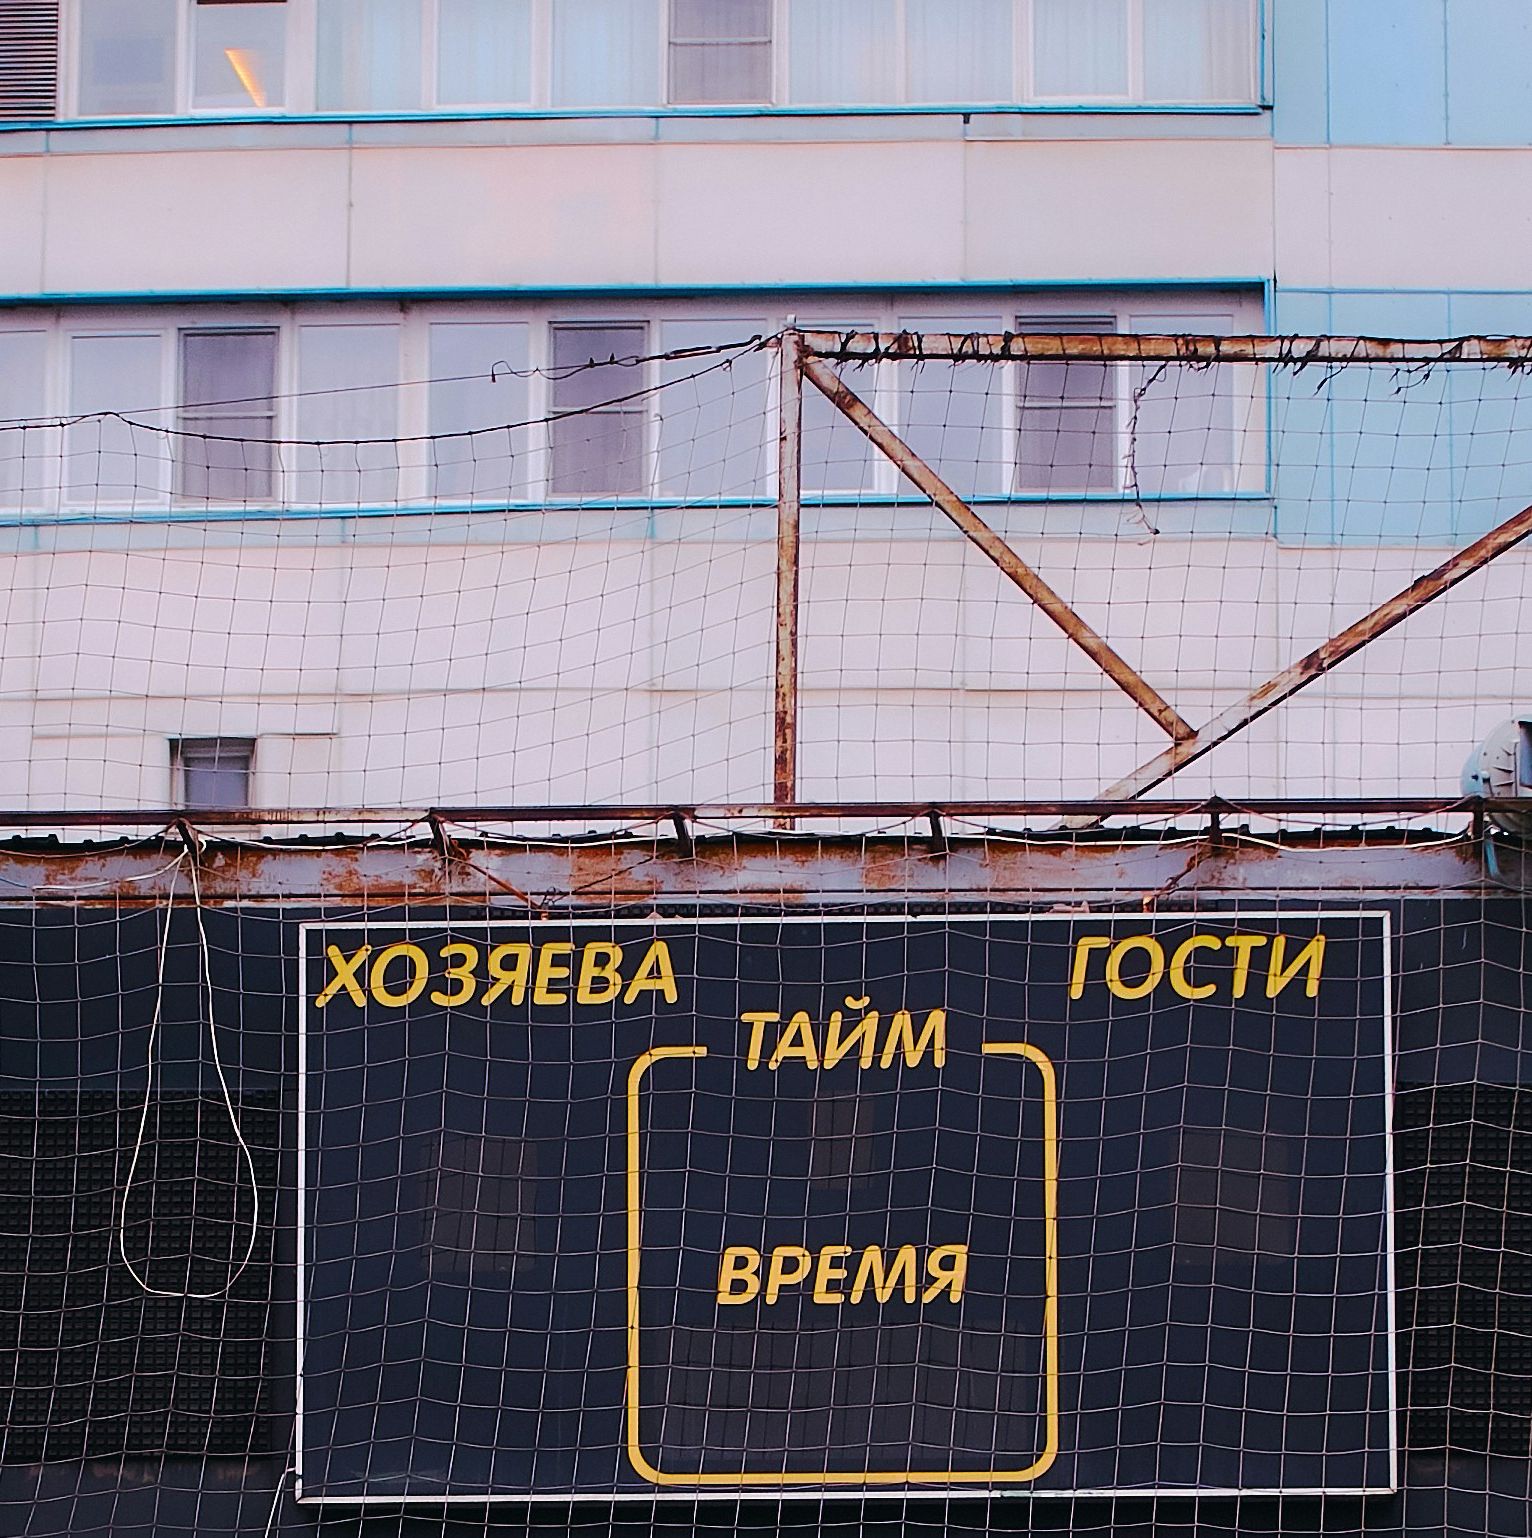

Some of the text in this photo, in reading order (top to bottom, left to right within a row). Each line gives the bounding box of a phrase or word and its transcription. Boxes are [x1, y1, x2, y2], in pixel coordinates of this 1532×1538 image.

[315, 940, 678, 1007] ХОЗЯЕВА
[1068, 933, 1326, 1000] ГОСТИ
[740, 995, 948, 1070] ТАЙМ
[716, 1244, 969, 1305] ВРЕМЯ
